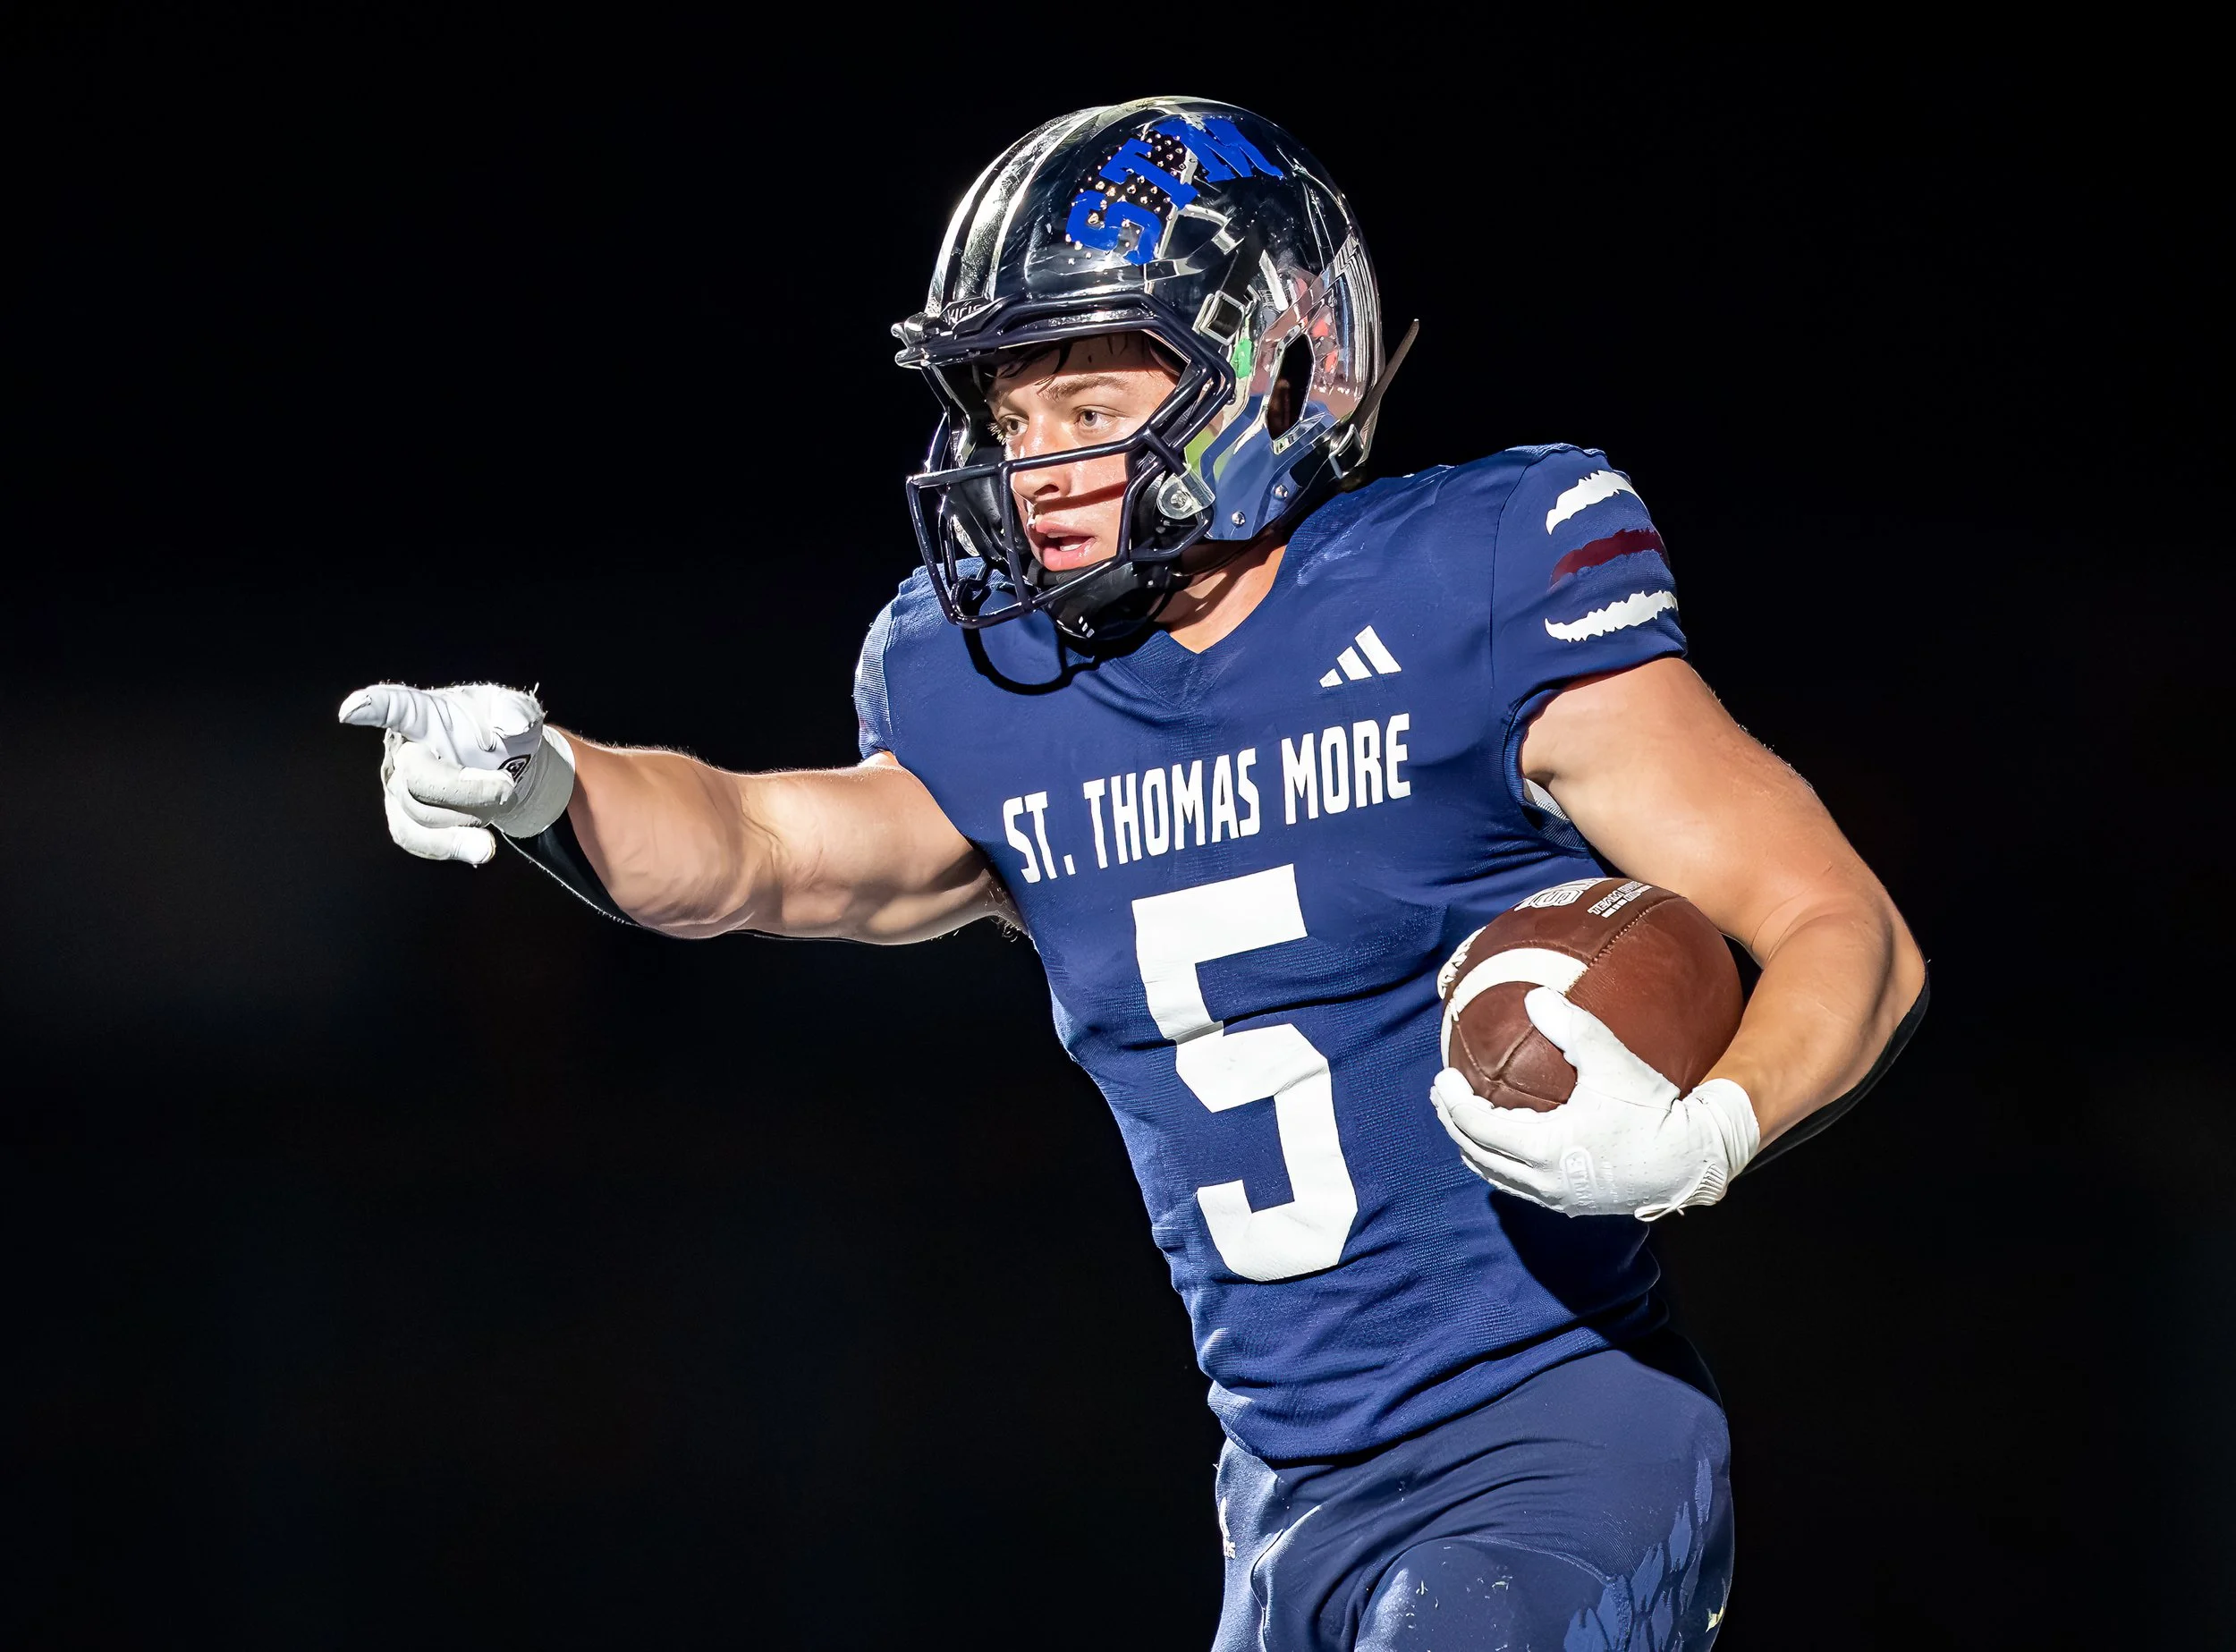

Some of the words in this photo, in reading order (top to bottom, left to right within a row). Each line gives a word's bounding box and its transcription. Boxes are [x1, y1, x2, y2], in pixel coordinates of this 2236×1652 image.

[1065, 118, 1283, 266] STM
[1003, 791, 1076, 884] ST.
[1082, 747, 1261, 869] THOMAS
[1281, 712, 1411, 826] MORE
[1131, 863, 1359, 1282] 5
